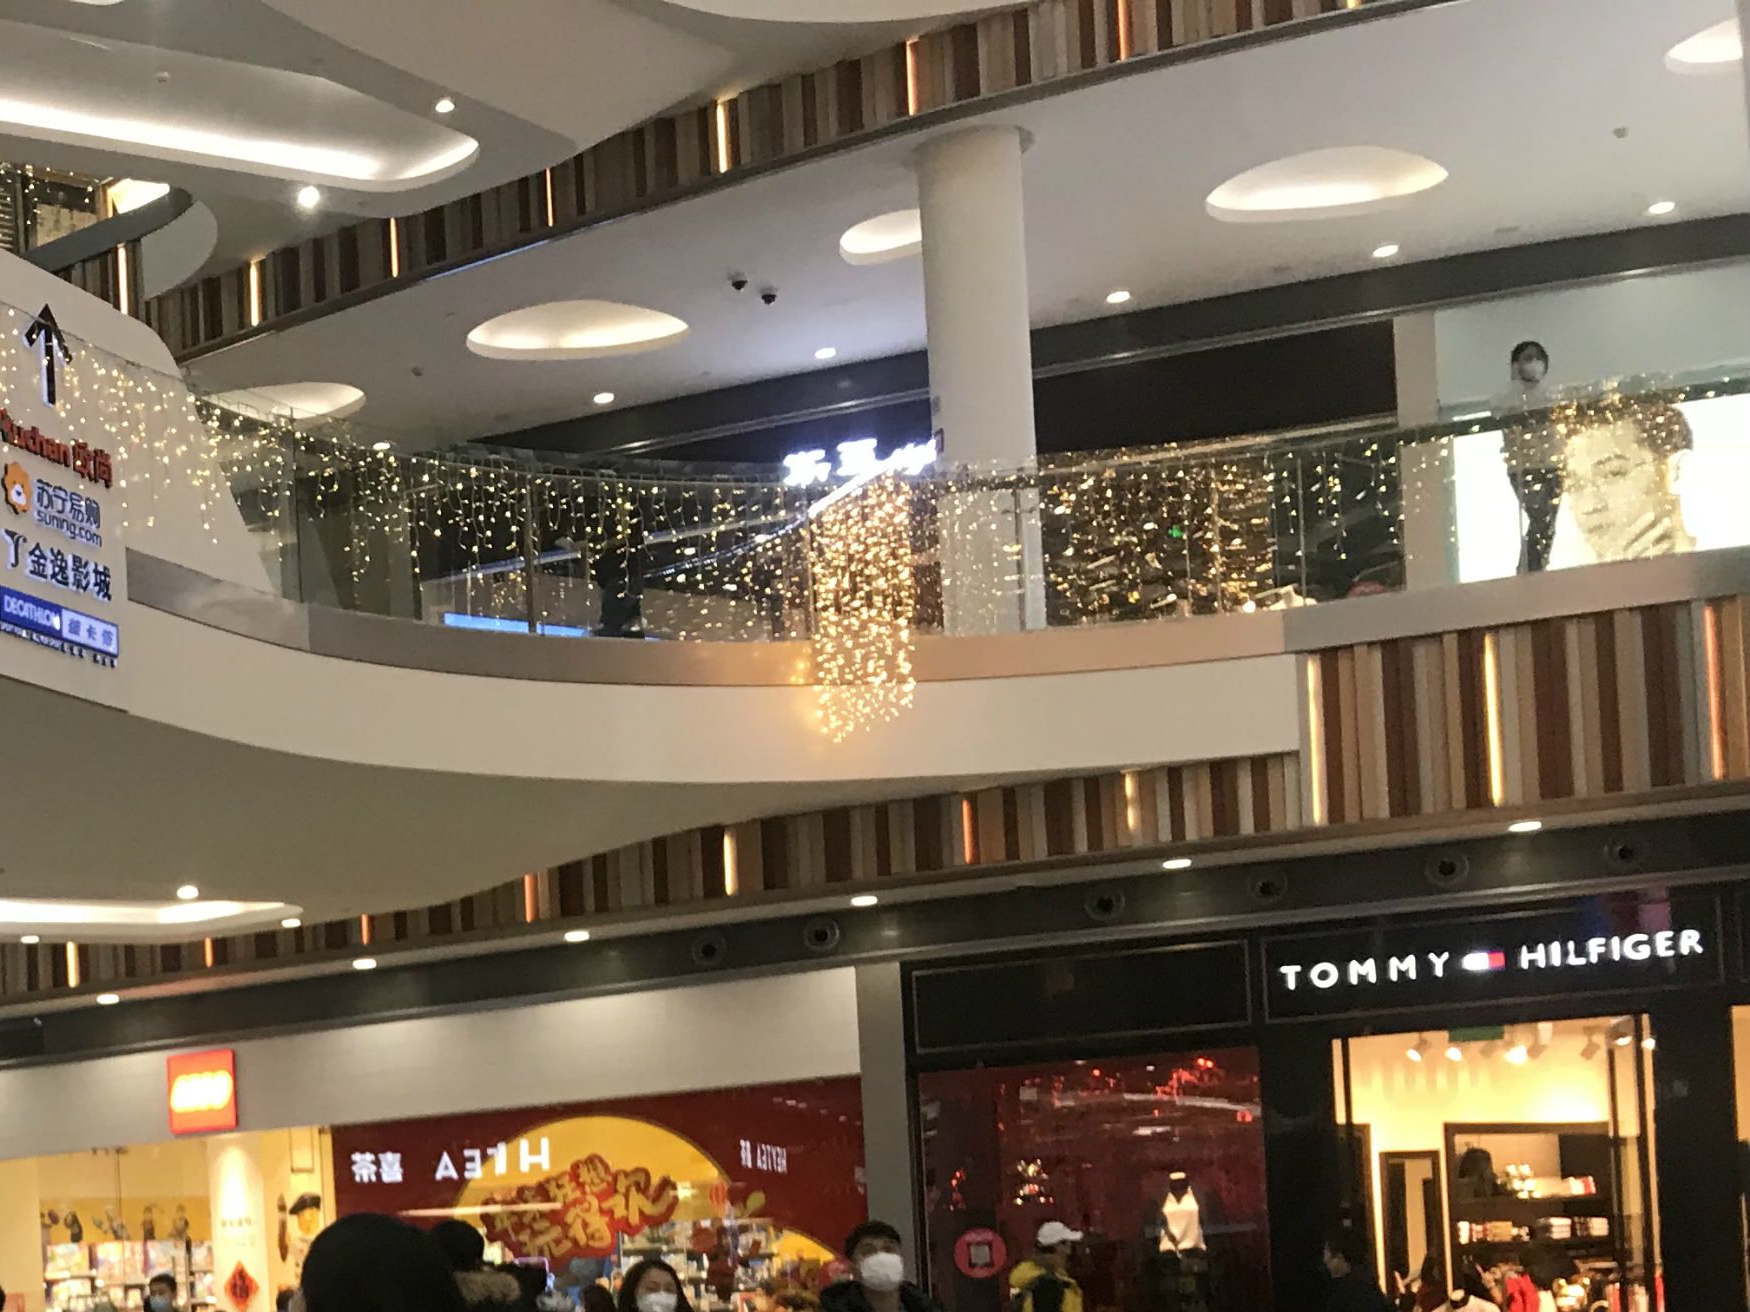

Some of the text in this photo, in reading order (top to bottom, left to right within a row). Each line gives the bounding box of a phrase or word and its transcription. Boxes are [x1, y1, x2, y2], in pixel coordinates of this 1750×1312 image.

[71, 439, 112, 488] 欧尚
[35, 478, 101, 529] 苏宁易购
[35, 509, 103, 547] suning.com
[27, 541, 112, 601] 金逸影城
[1278, 928, 1705, 991] TOMMY HILFIGER
